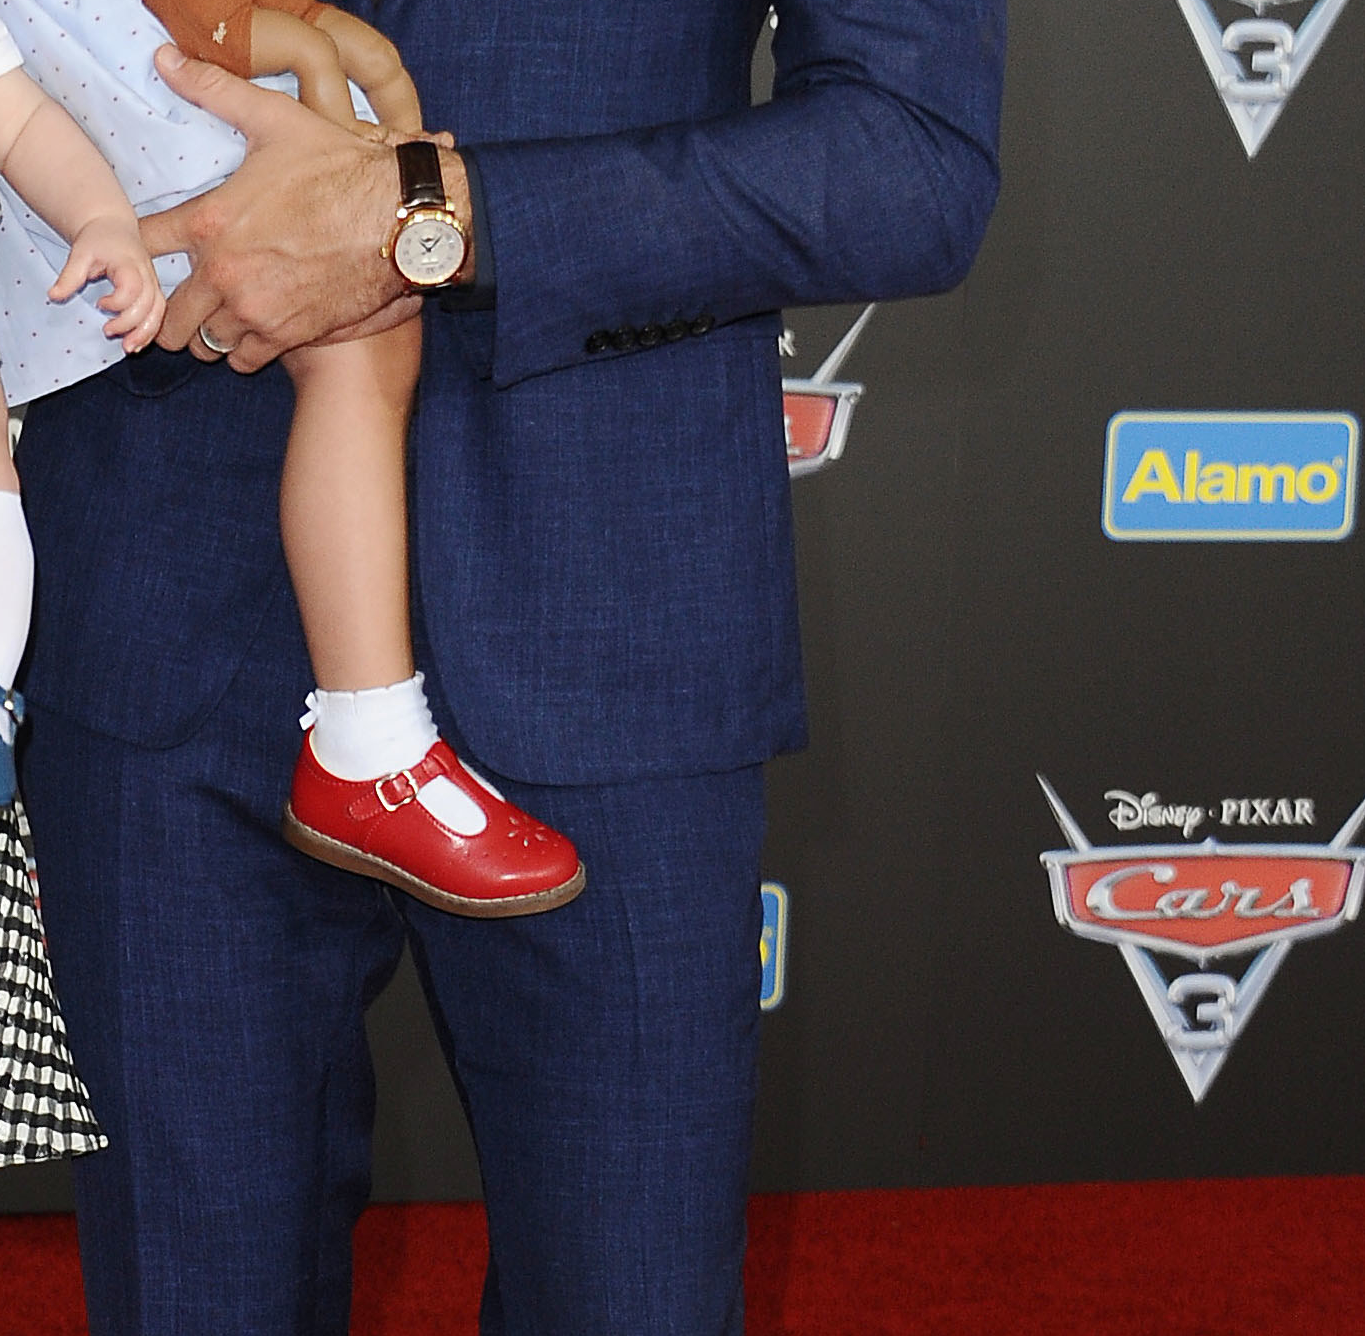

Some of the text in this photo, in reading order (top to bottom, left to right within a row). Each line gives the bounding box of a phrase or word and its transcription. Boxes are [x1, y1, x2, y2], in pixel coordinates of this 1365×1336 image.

[1219, 18, 1293, 102] 3
[1122, 450, 1338, 504] Alamo
[1104, 790, 1315, 837] Disney PIXAR
[1085, 864, 1321, 921] Cars
[1166, 973, 1236, 1050] 3
